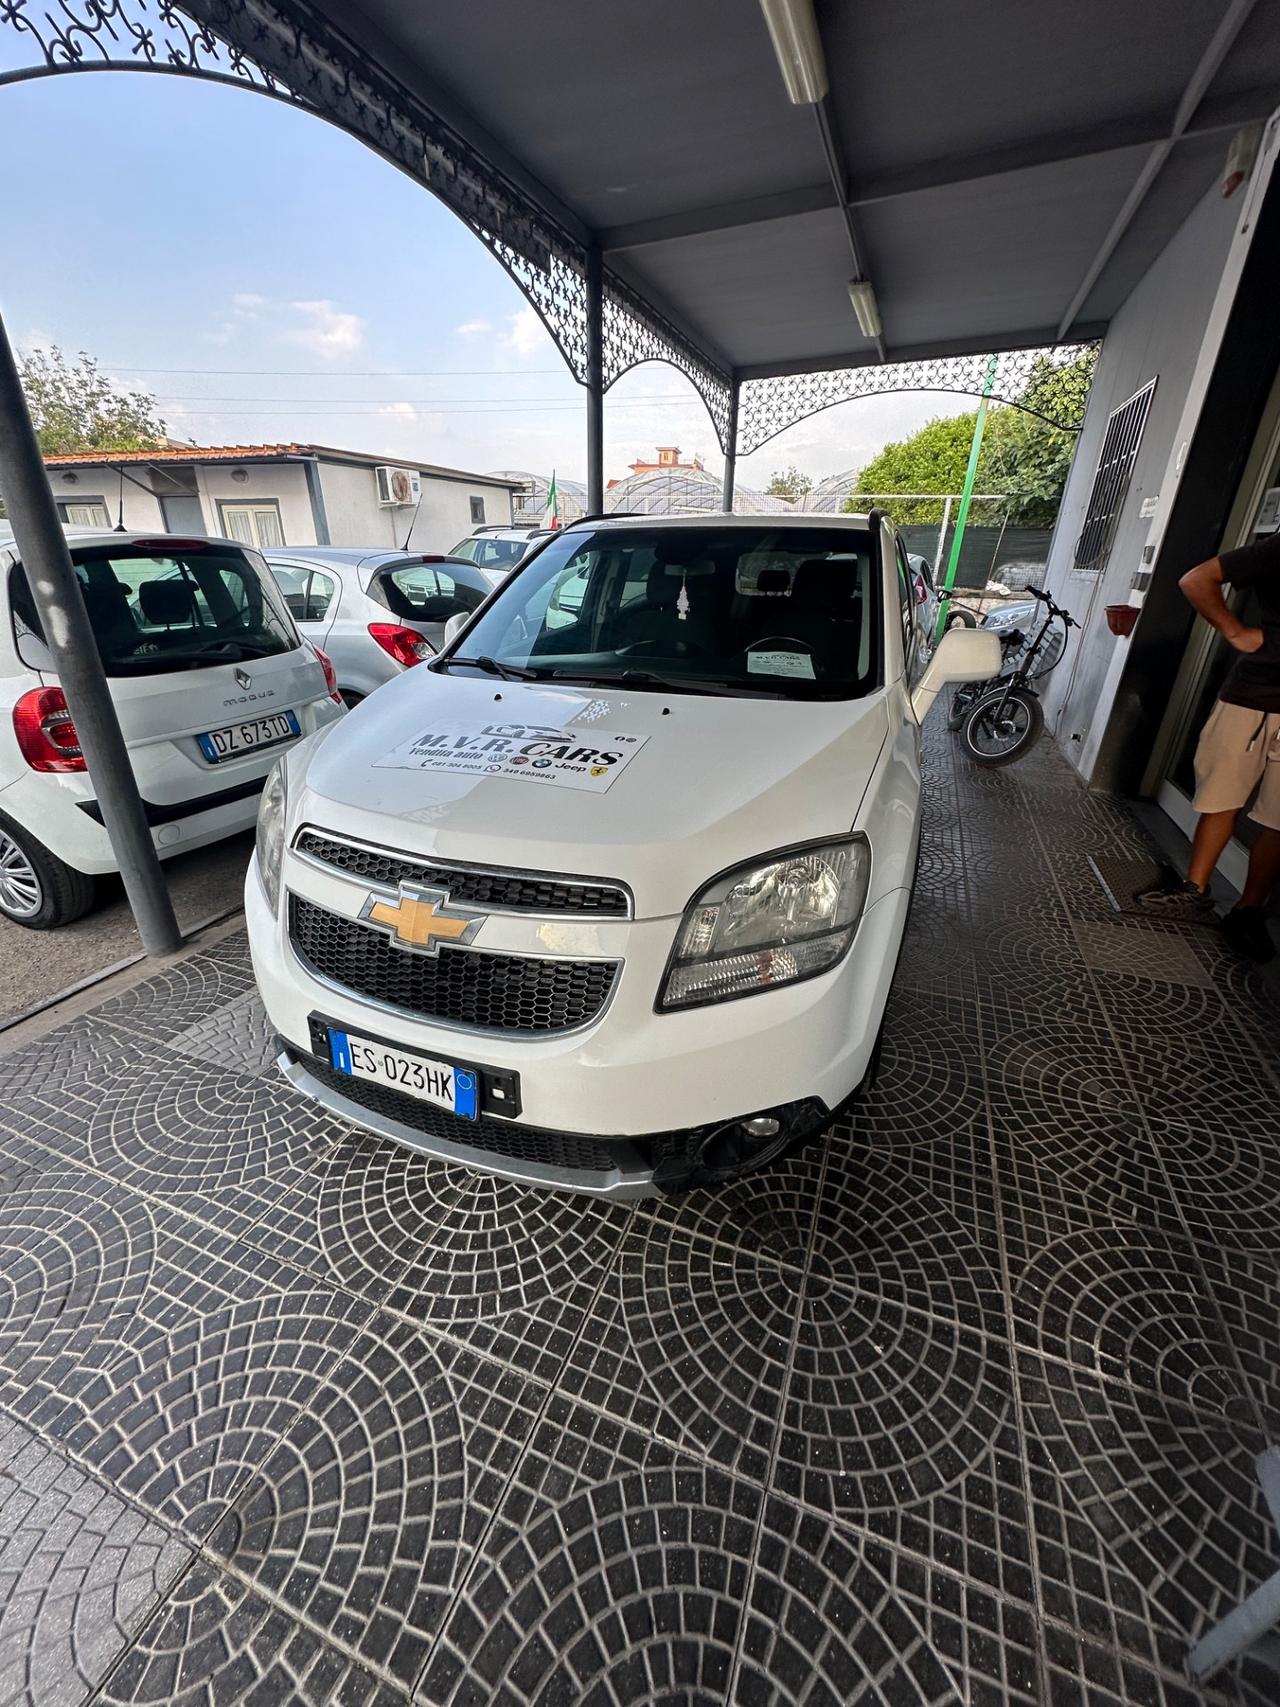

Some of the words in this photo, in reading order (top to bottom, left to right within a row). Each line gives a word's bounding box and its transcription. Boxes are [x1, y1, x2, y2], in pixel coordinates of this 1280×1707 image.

[212, 730, 239, 753] DZ
[241, 716, 290, 745] 673TD
[411, 734, 514, 752] M.V.R.
[519, 742, 624, 766] CARS
[453, 751, 484, 760] auto
[554, 762, 587, 773] Jeep
[349, 1043, 378, 1074] ES
[383, 1054, 454, 1101] 023HK
